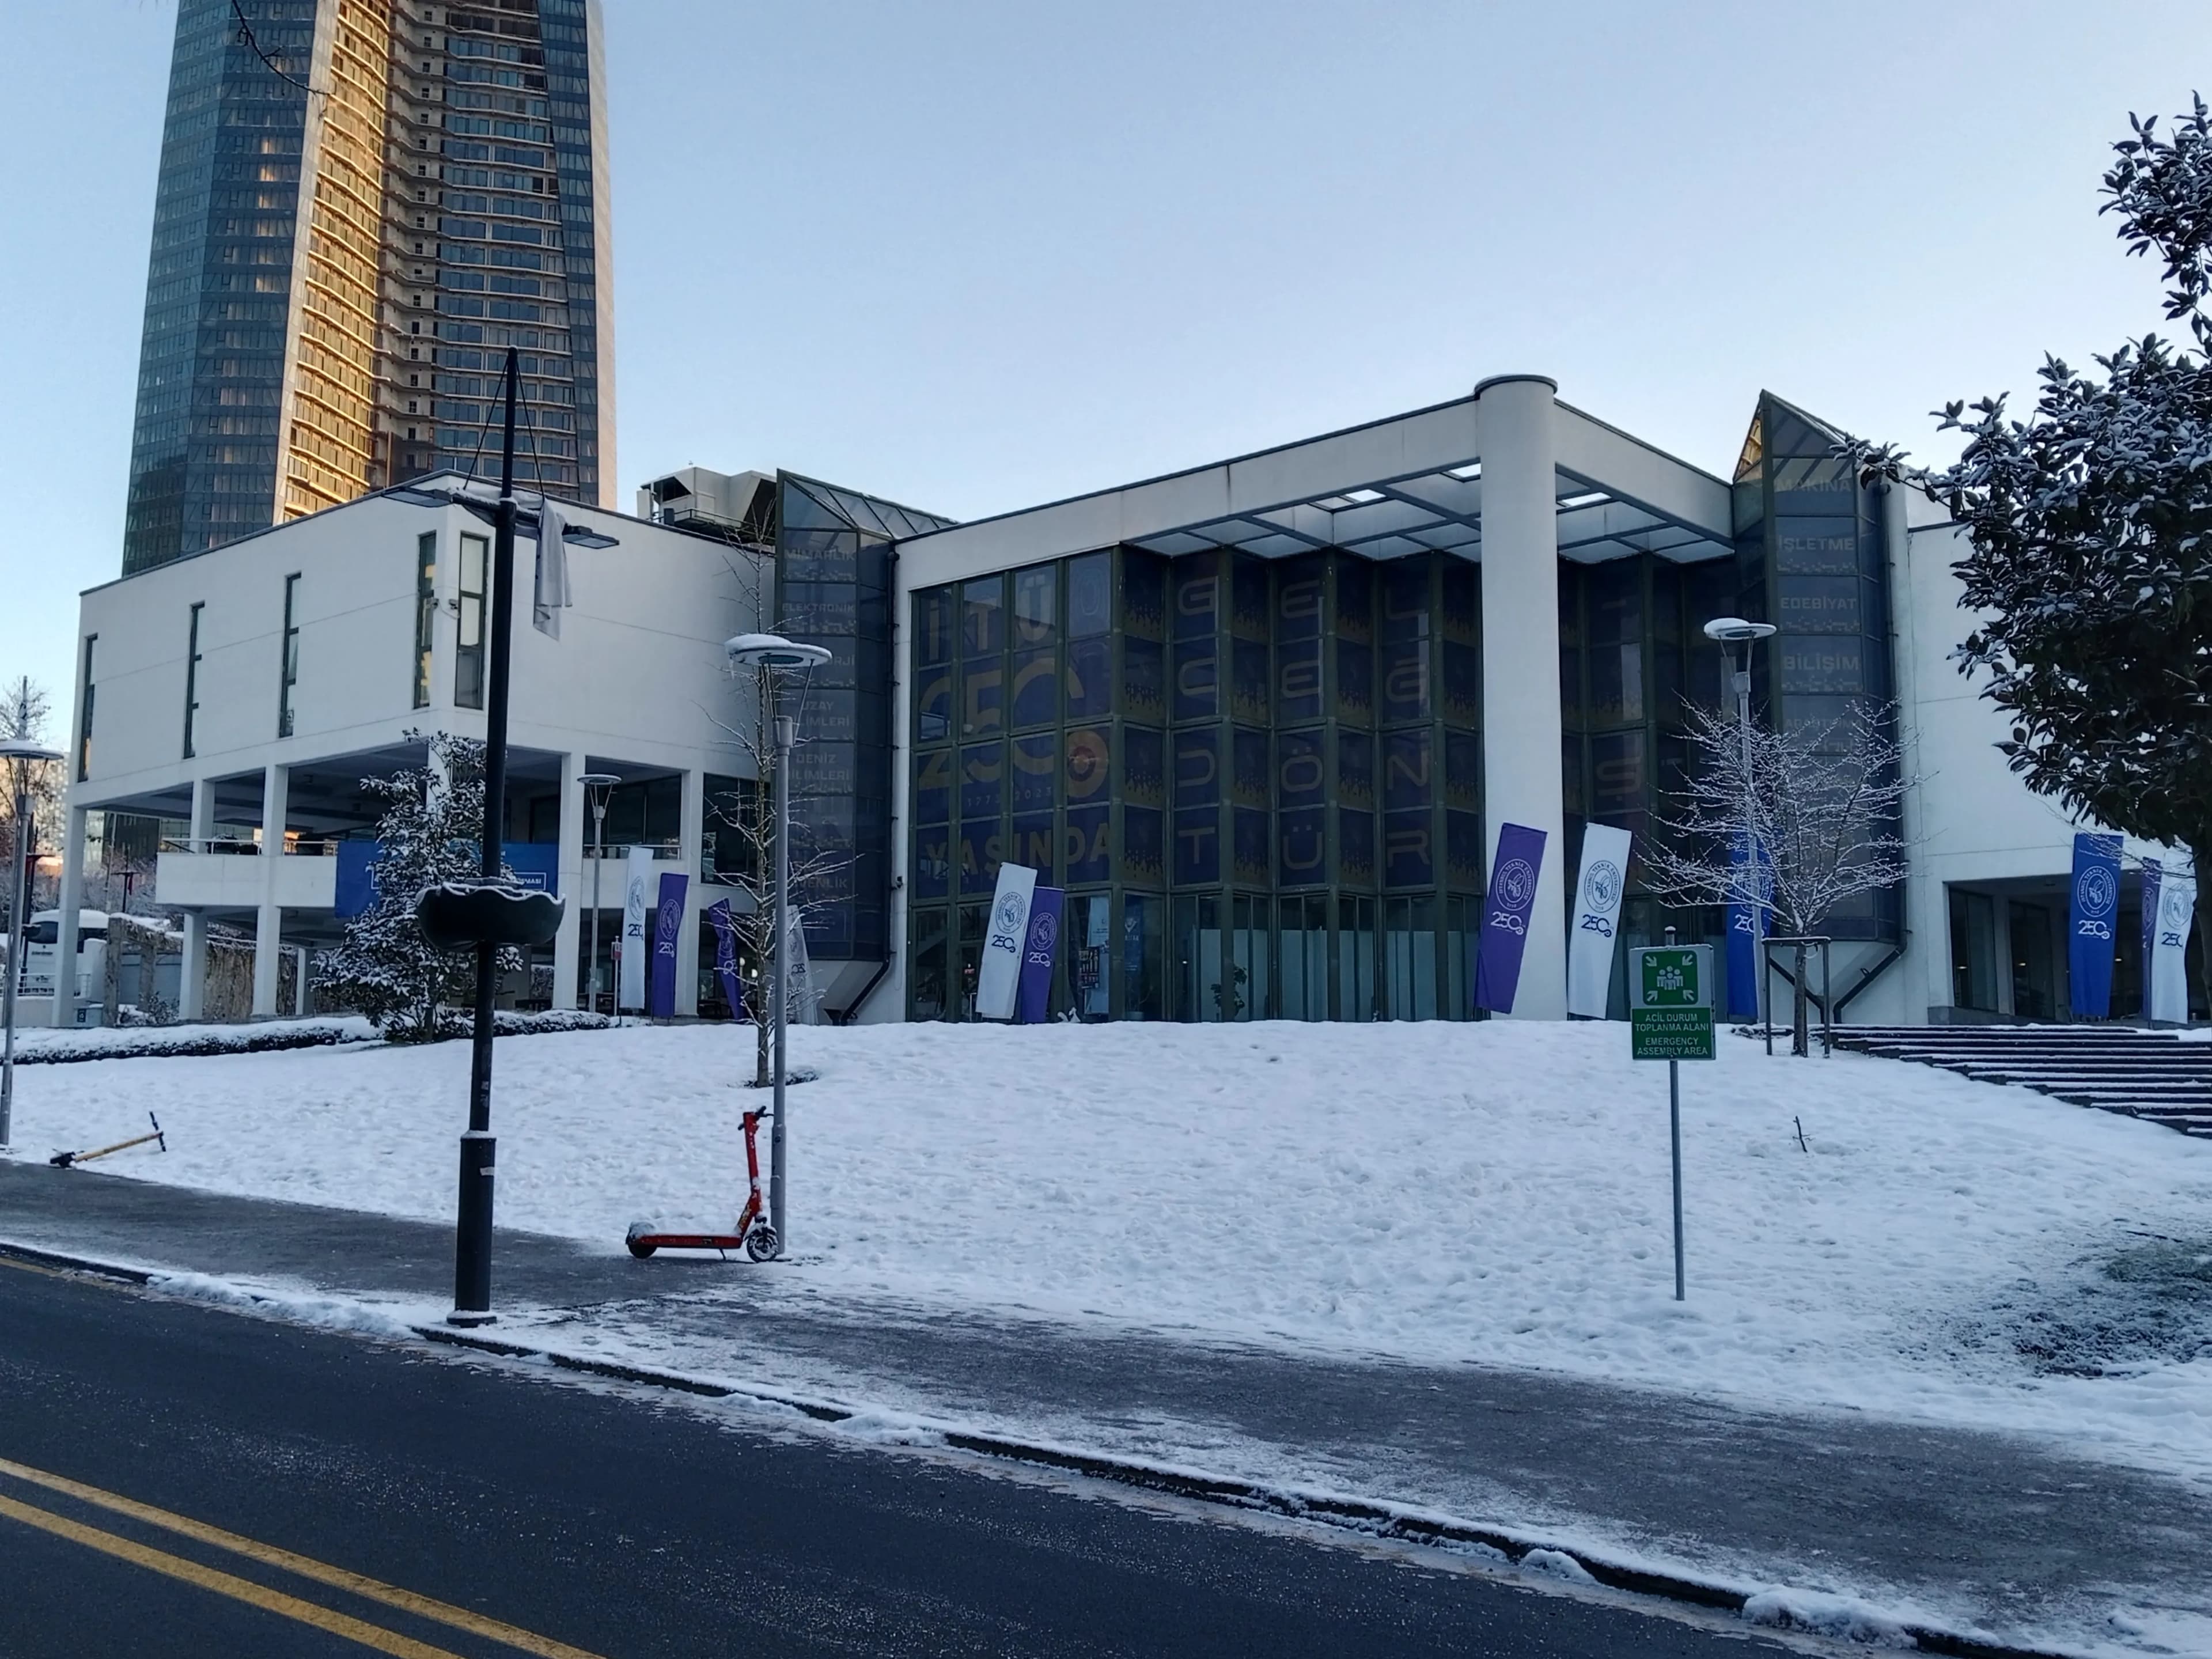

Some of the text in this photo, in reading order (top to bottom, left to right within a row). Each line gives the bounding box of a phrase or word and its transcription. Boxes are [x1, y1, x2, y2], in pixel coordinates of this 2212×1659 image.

[1779, 535, 1855, 552] İŞLETME
[1780, 596, 1857, 609] EDEBİYAT
[1783, 652, 1859, 673] BİLİŞİM
[796, 752, 837, 764] DENİZ
[789, 768, 850, 781] İLİMLERİ
[926, 822, 1110, 880] YAŞINDA
[1178, 824, 1431, 871] TÜR
[800, 876, 849, 888] VENLİK
[1645, 1012, 1698, 1022] ACİL DURUM
[1635, 1023, 1709, 1032] TOPLANMA ALANI
[1645, 1037, 1699, 1046] EMERGENCY
[1637, 1047, 1708, 1055] ASSEMBLY AREA
